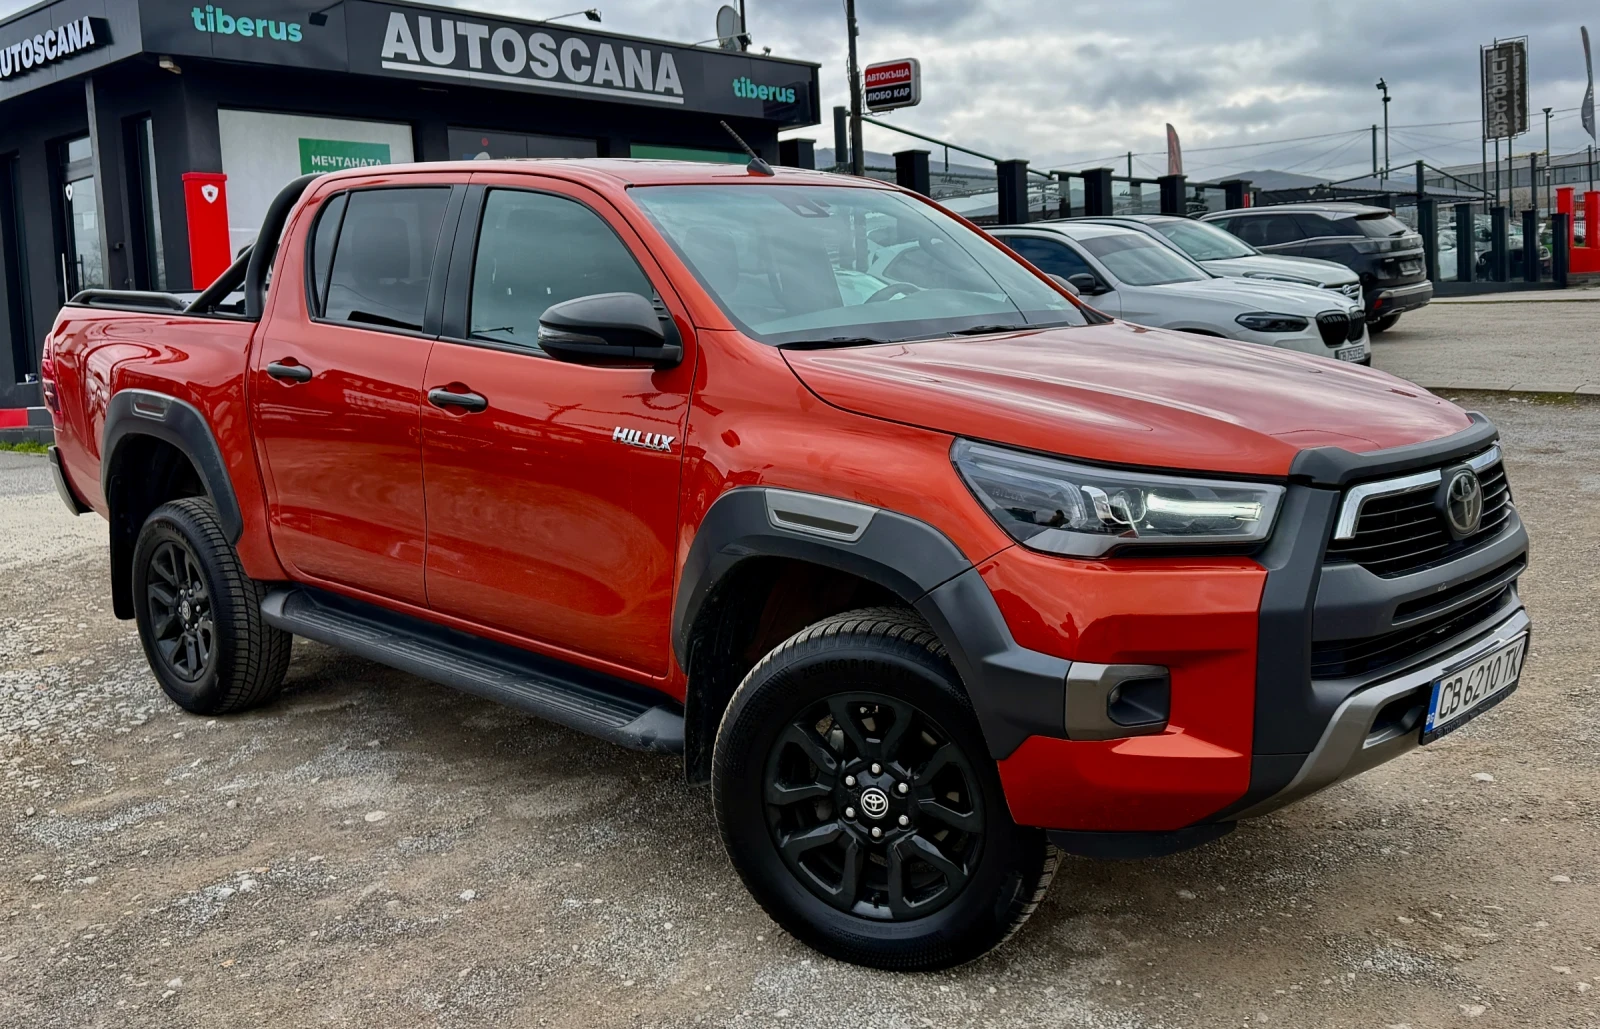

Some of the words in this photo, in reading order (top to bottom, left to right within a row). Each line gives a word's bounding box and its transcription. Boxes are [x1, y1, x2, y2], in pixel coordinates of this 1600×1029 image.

[191, 4, 303, 42] tiberus
[0, 16, 95, 78] UTOSCANA
[381, 11, 684, 95] AUTOSCANA
[732, 76, 796, 103] tiberus
[866, 68, 910, 82] АВТОКЪЩА
[867, 90, 892, 102] ЛЮБО
[893, 87, 910, 98] КАР
[612, 426, 676, 453] HILUX
[1439, 676, 1463, 719] CB
[1463, 655, 1502, 706] 6210
[1502, 643, 1522, 684] TK
